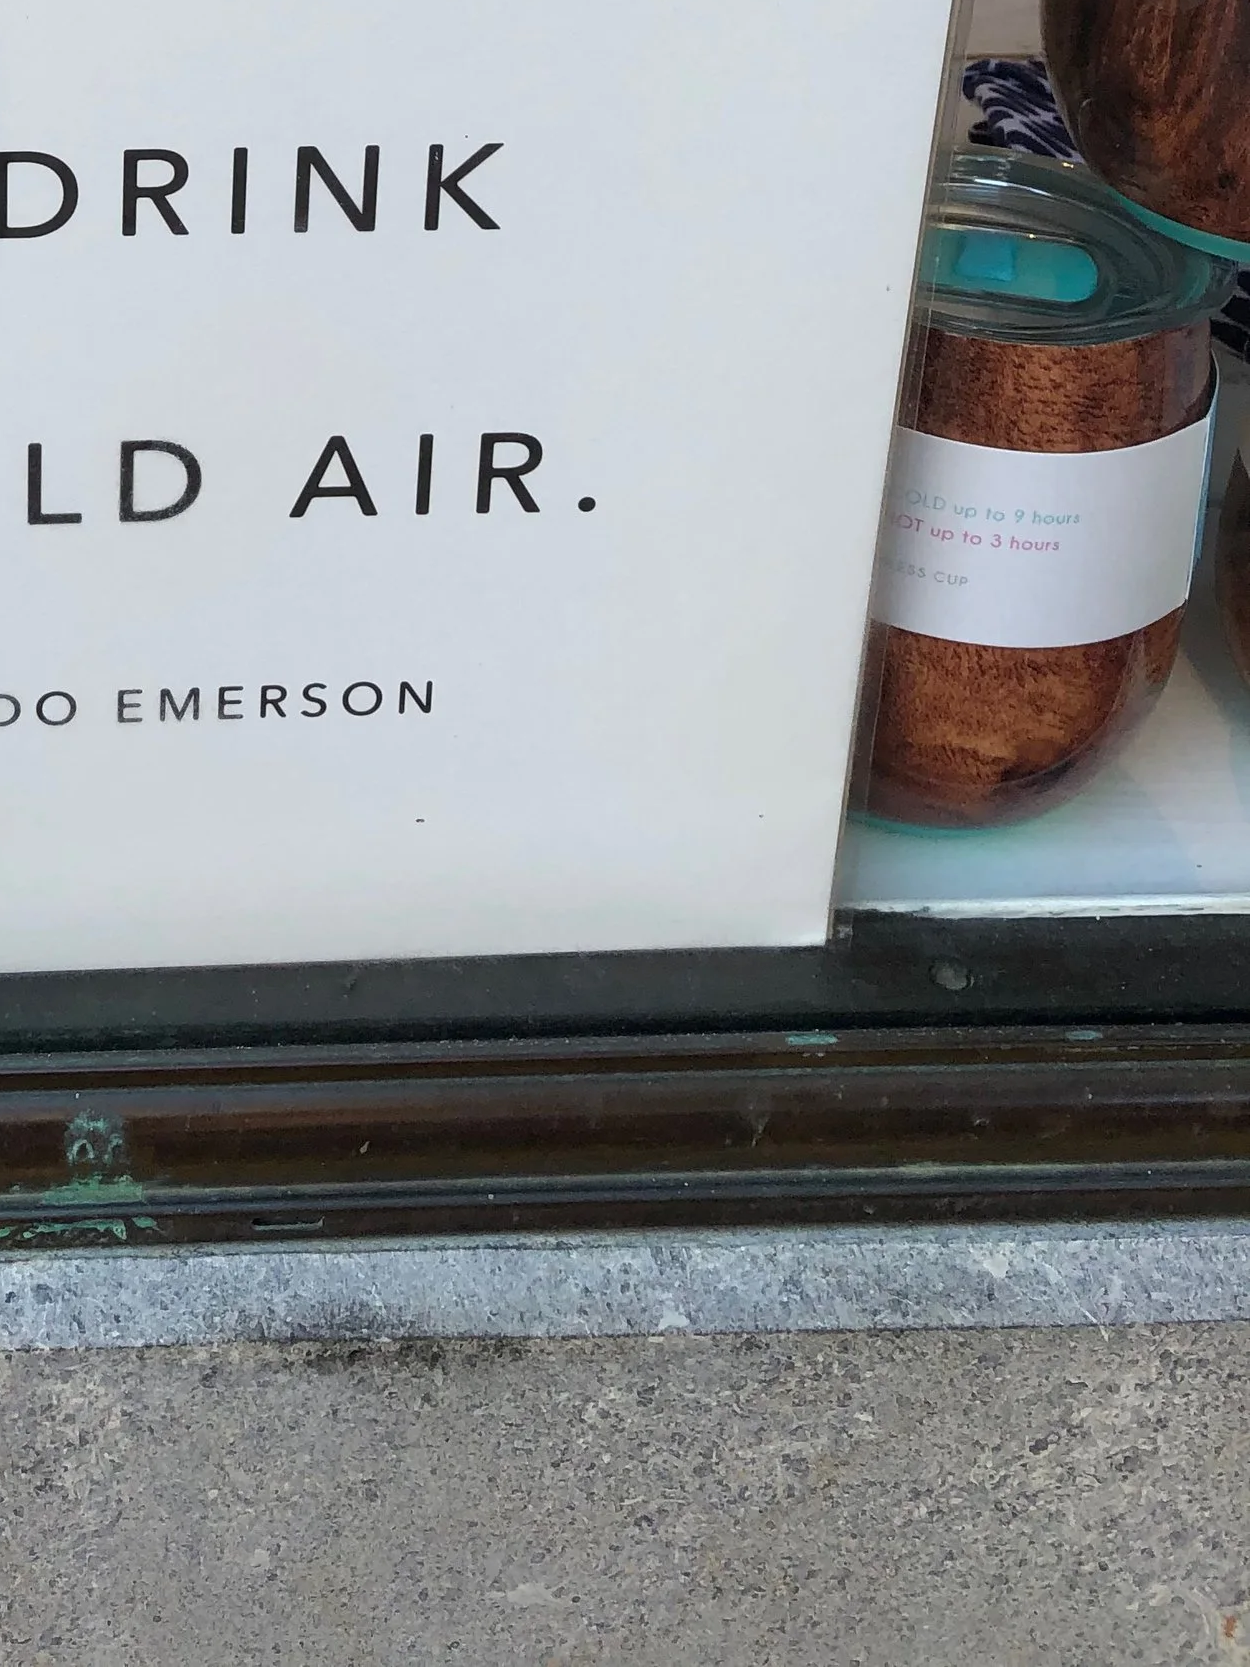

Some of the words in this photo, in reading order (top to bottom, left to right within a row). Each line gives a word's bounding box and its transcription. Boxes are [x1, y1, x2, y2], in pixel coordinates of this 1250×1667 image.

[288, 431, 597, 519] AIR.
[953, 502, 978, 520] up
[986, 507, 1006, 523] to
[1013, 508, 1026, 524] 9
[1031, 509, 1081, 527] hours
[930, 525, 955, 542] up
[962, 530, 983, 546] to
[989, 533, 1003, 549] 3
[1009, 535, 1061, 552] hours
[934, 569, 969, 587] CUP
[116, 680, 434, 724] EMERSON
